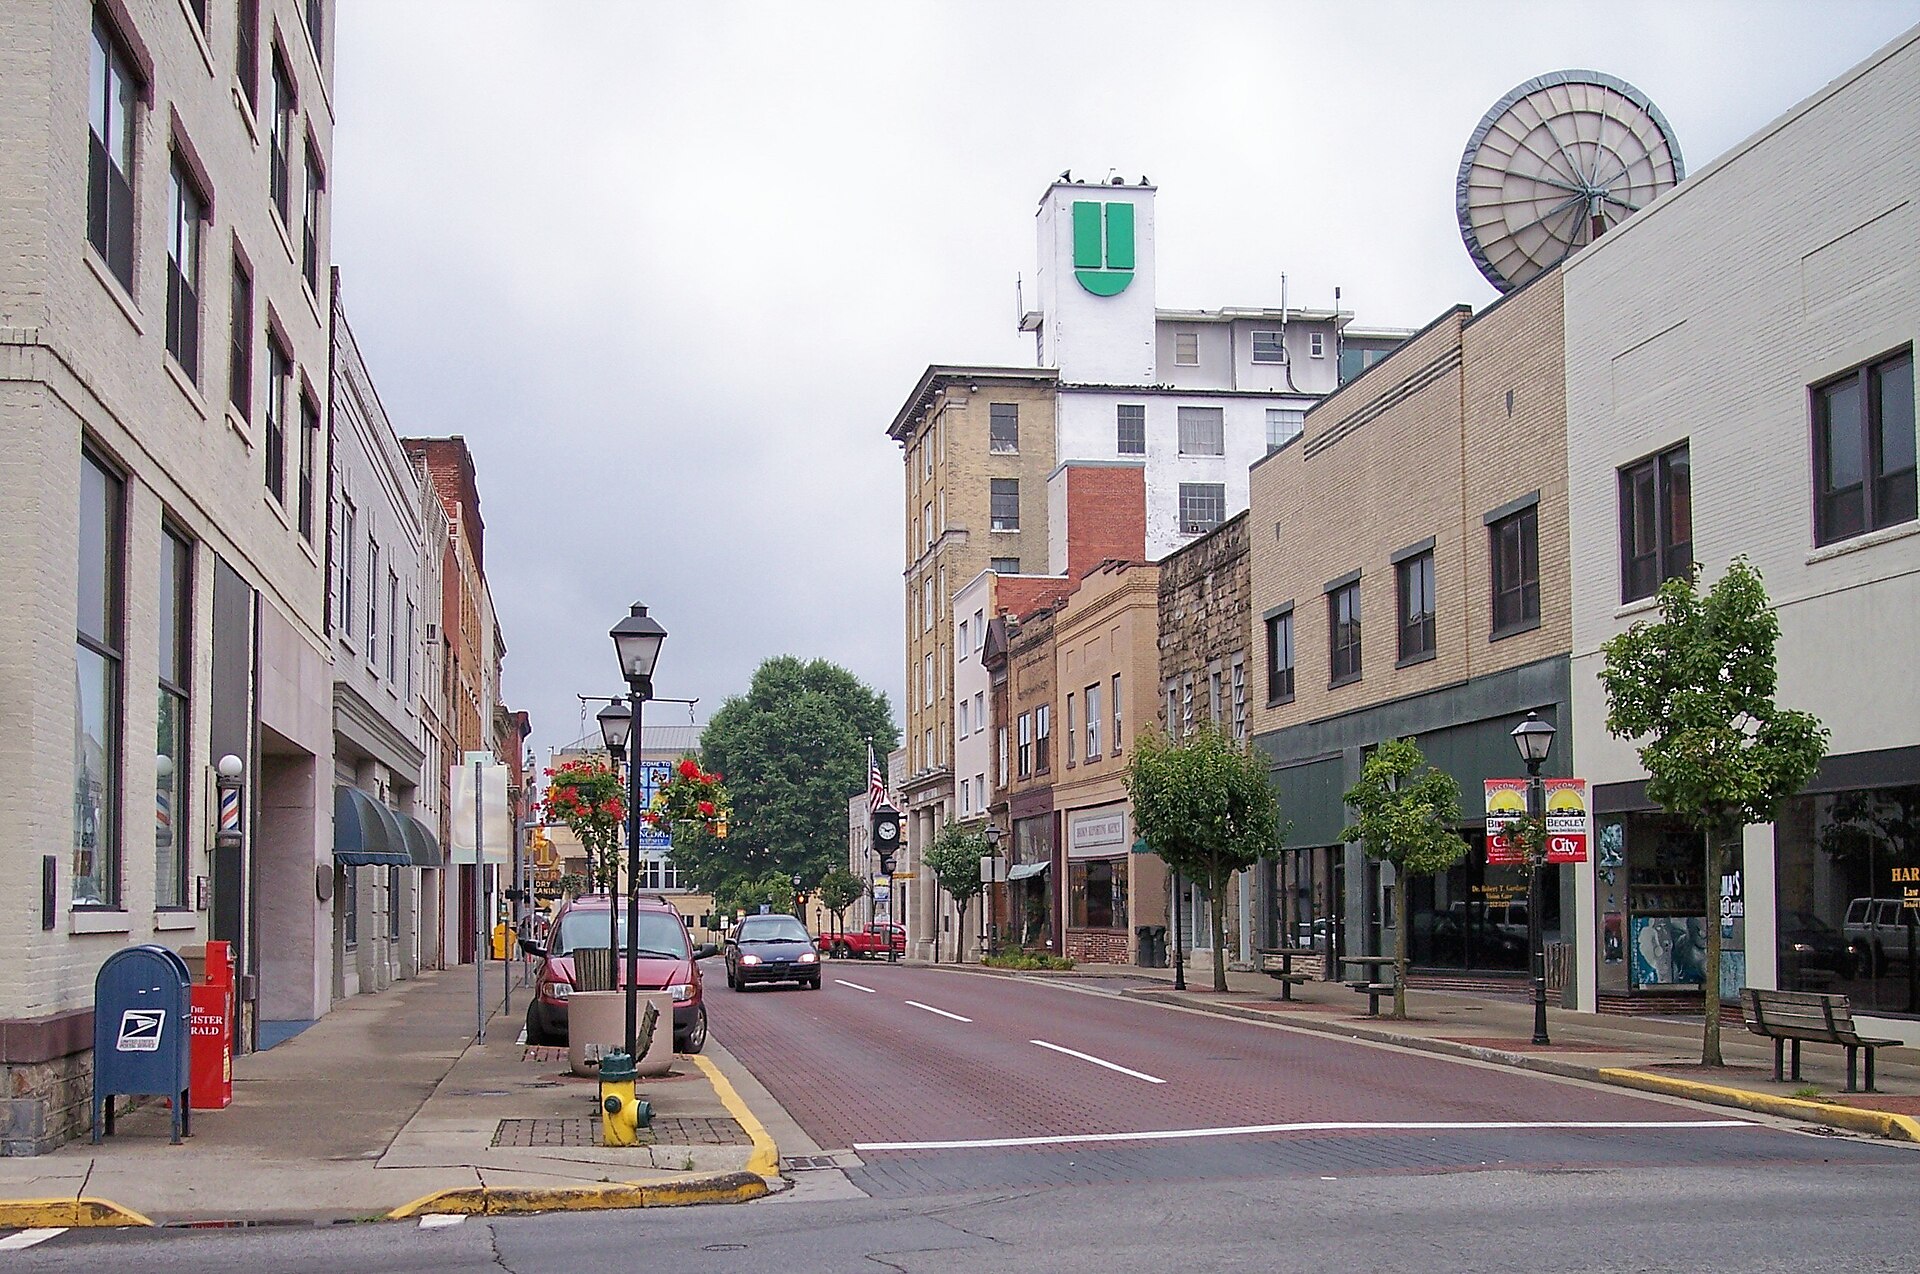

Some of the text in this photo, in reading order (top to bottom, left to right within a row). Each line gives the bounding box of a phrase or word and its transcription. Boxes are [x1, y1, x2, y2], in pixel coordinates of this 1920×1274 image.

[1547, 818, 1585, 828] BECKLEY
[1551, 837, 1579, 856] City
[1903, 886, 1919, 897] Law
[191, 1016, 223, 1025] ISTER
[191, 1026, 220, 1035] RALD
